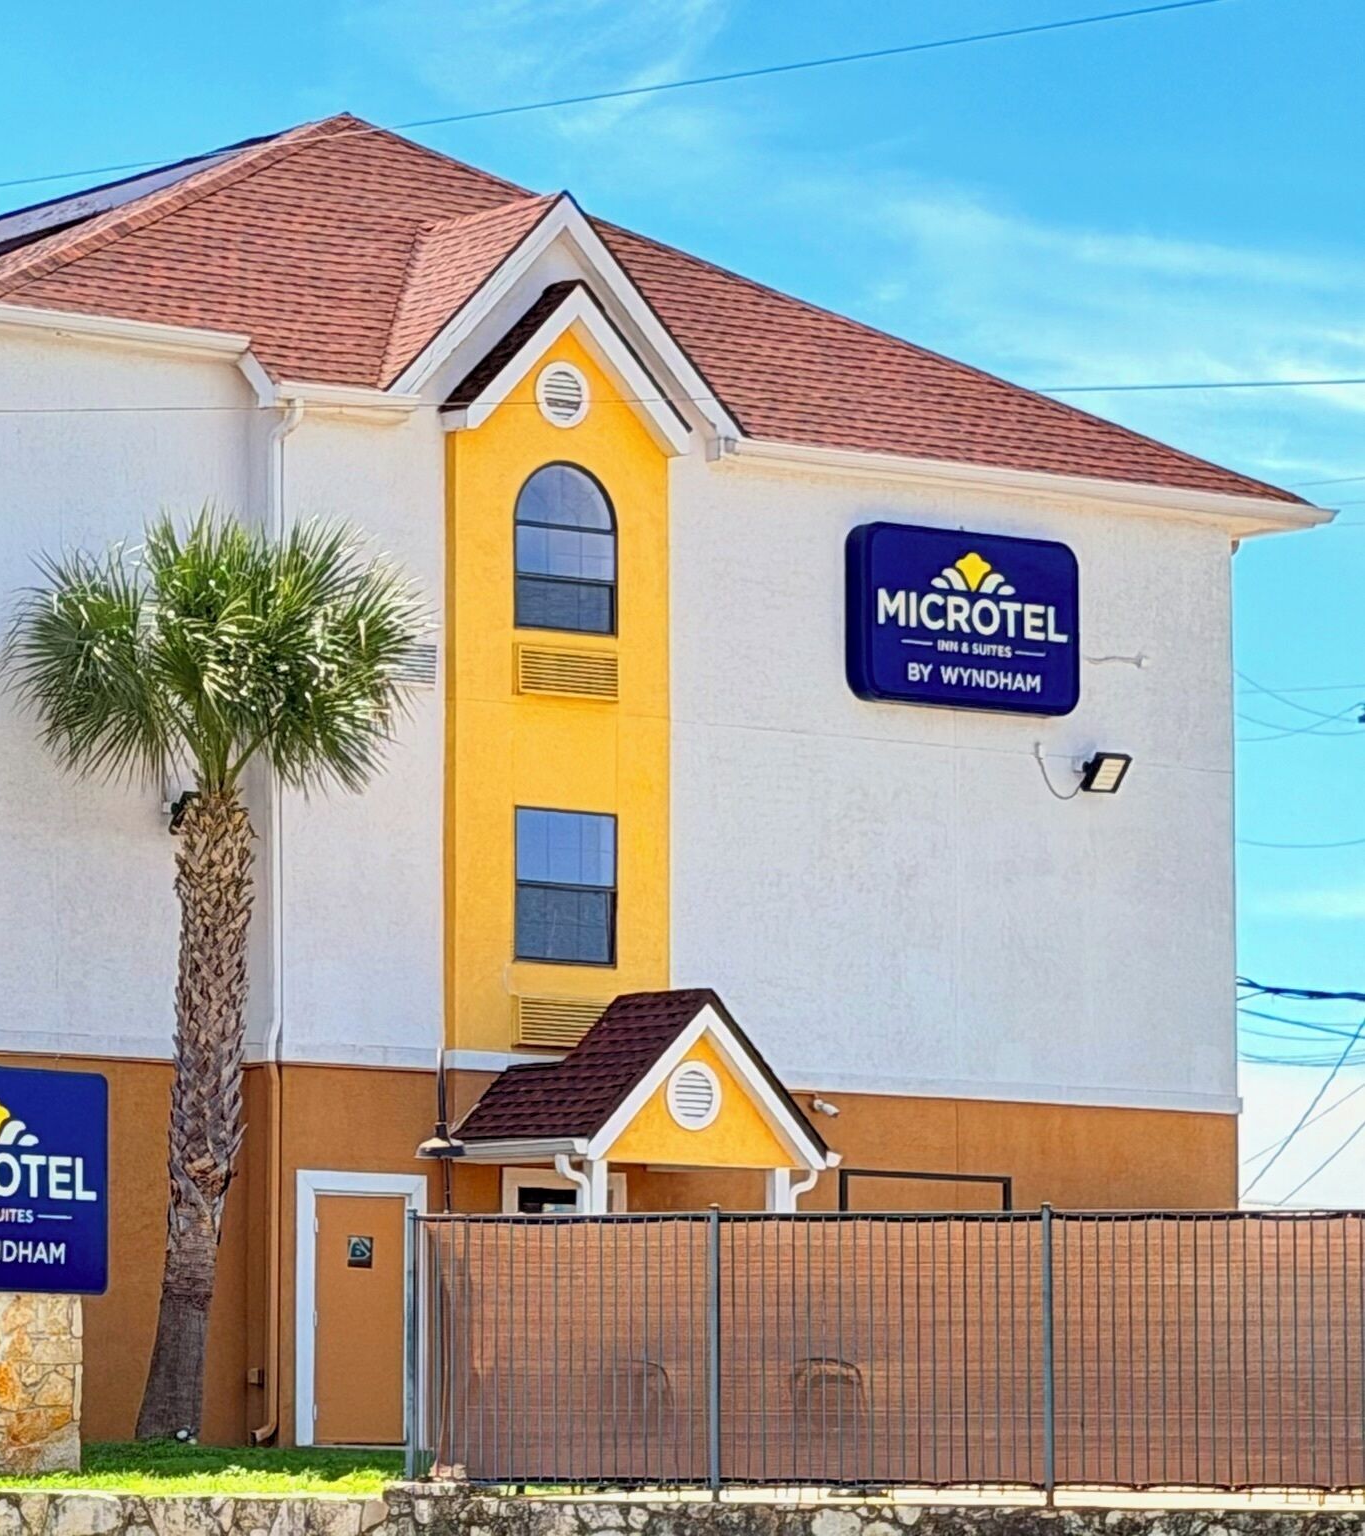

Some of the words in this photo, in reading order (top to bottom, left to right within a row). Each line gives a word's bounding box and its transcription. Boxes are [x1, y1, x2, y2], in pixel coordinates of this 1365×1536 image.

[877, 588, 1068, 643] MICROTEL
[937, 639, 959, 653] INN
[961, 641, 969, 654] &
[972, 644, 1013, 658] SUITES
[907, 662, 933, 682] BY
[940, 665, 1042, 693] WYNDHAM
